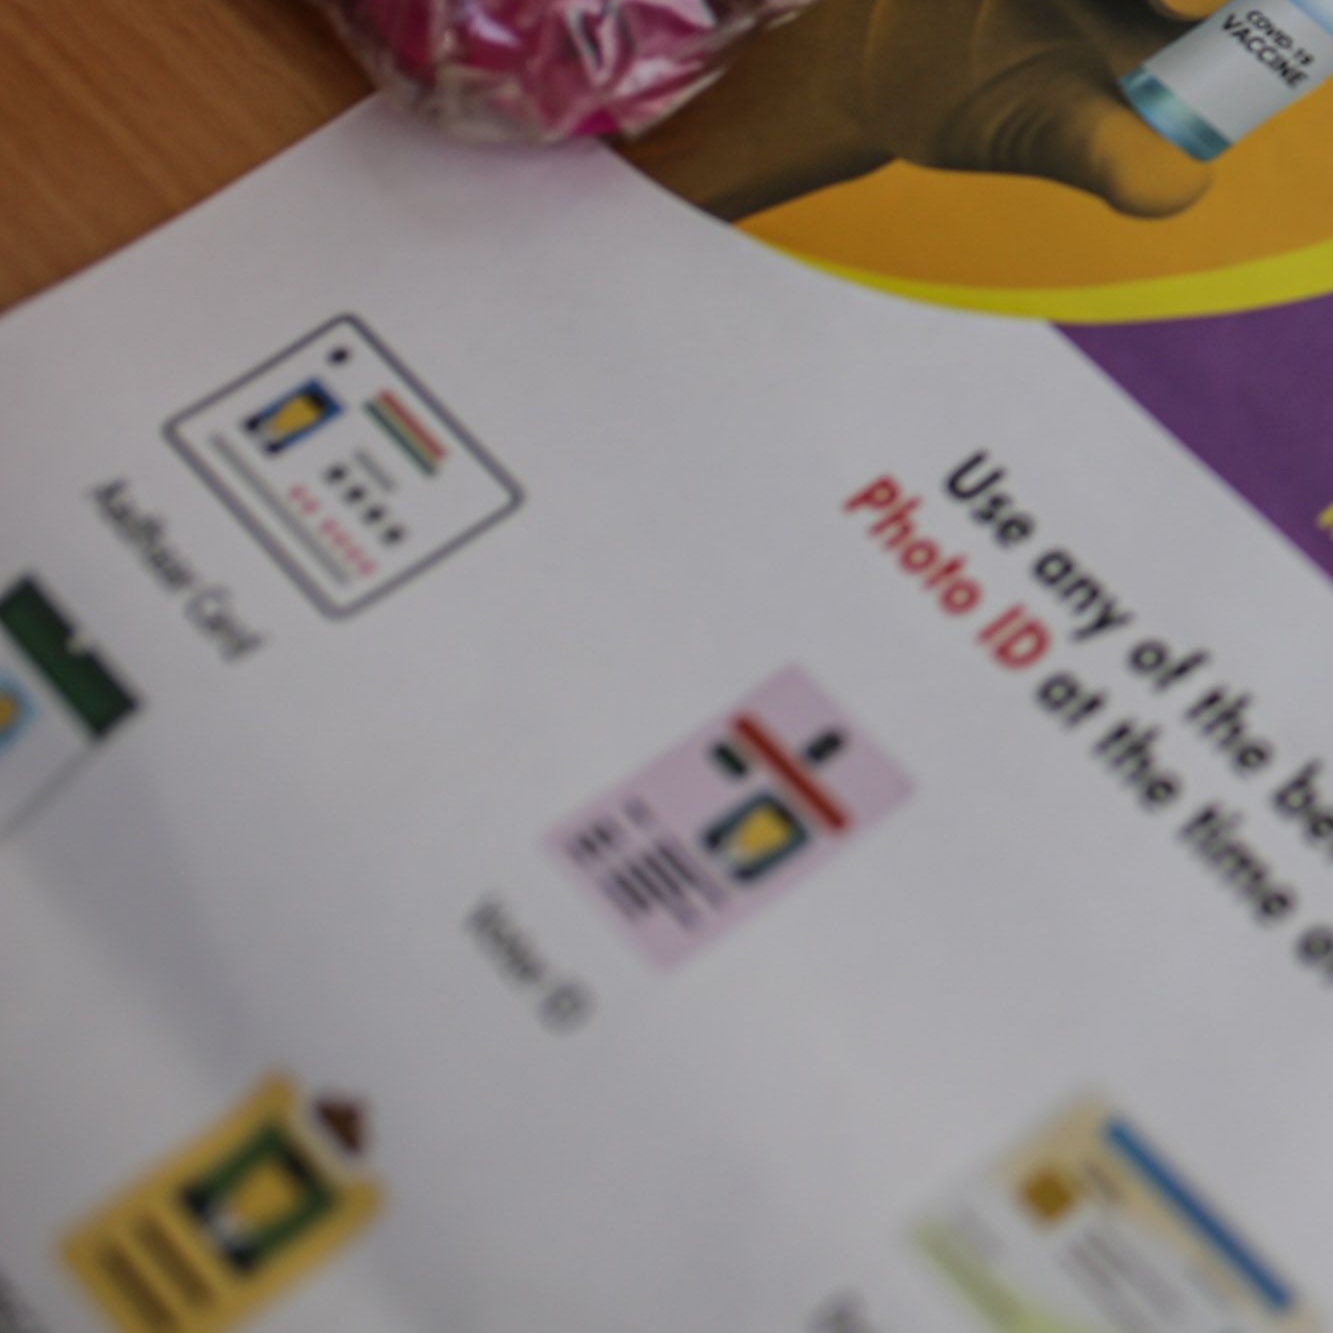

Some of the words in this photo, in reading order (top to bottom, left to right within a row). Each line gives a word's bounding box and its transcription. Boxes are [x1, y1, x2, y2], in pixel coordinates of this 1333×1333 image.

[1223, 14, 1307, 87] VACCINE
[842, 474, 952, 588] Photo
[980, 607, 1049, 668] ID
[1036, 673, 1105, 726] at
[1095, 721, 1180, 807] the
[1180, 804, 1295, 922] time
[944, 451, 1034, 547] Use
[1032, 549, 1129, 641] any
[1127, 640, 1209, 691] of
[1186, 688, 1272, 773] the
